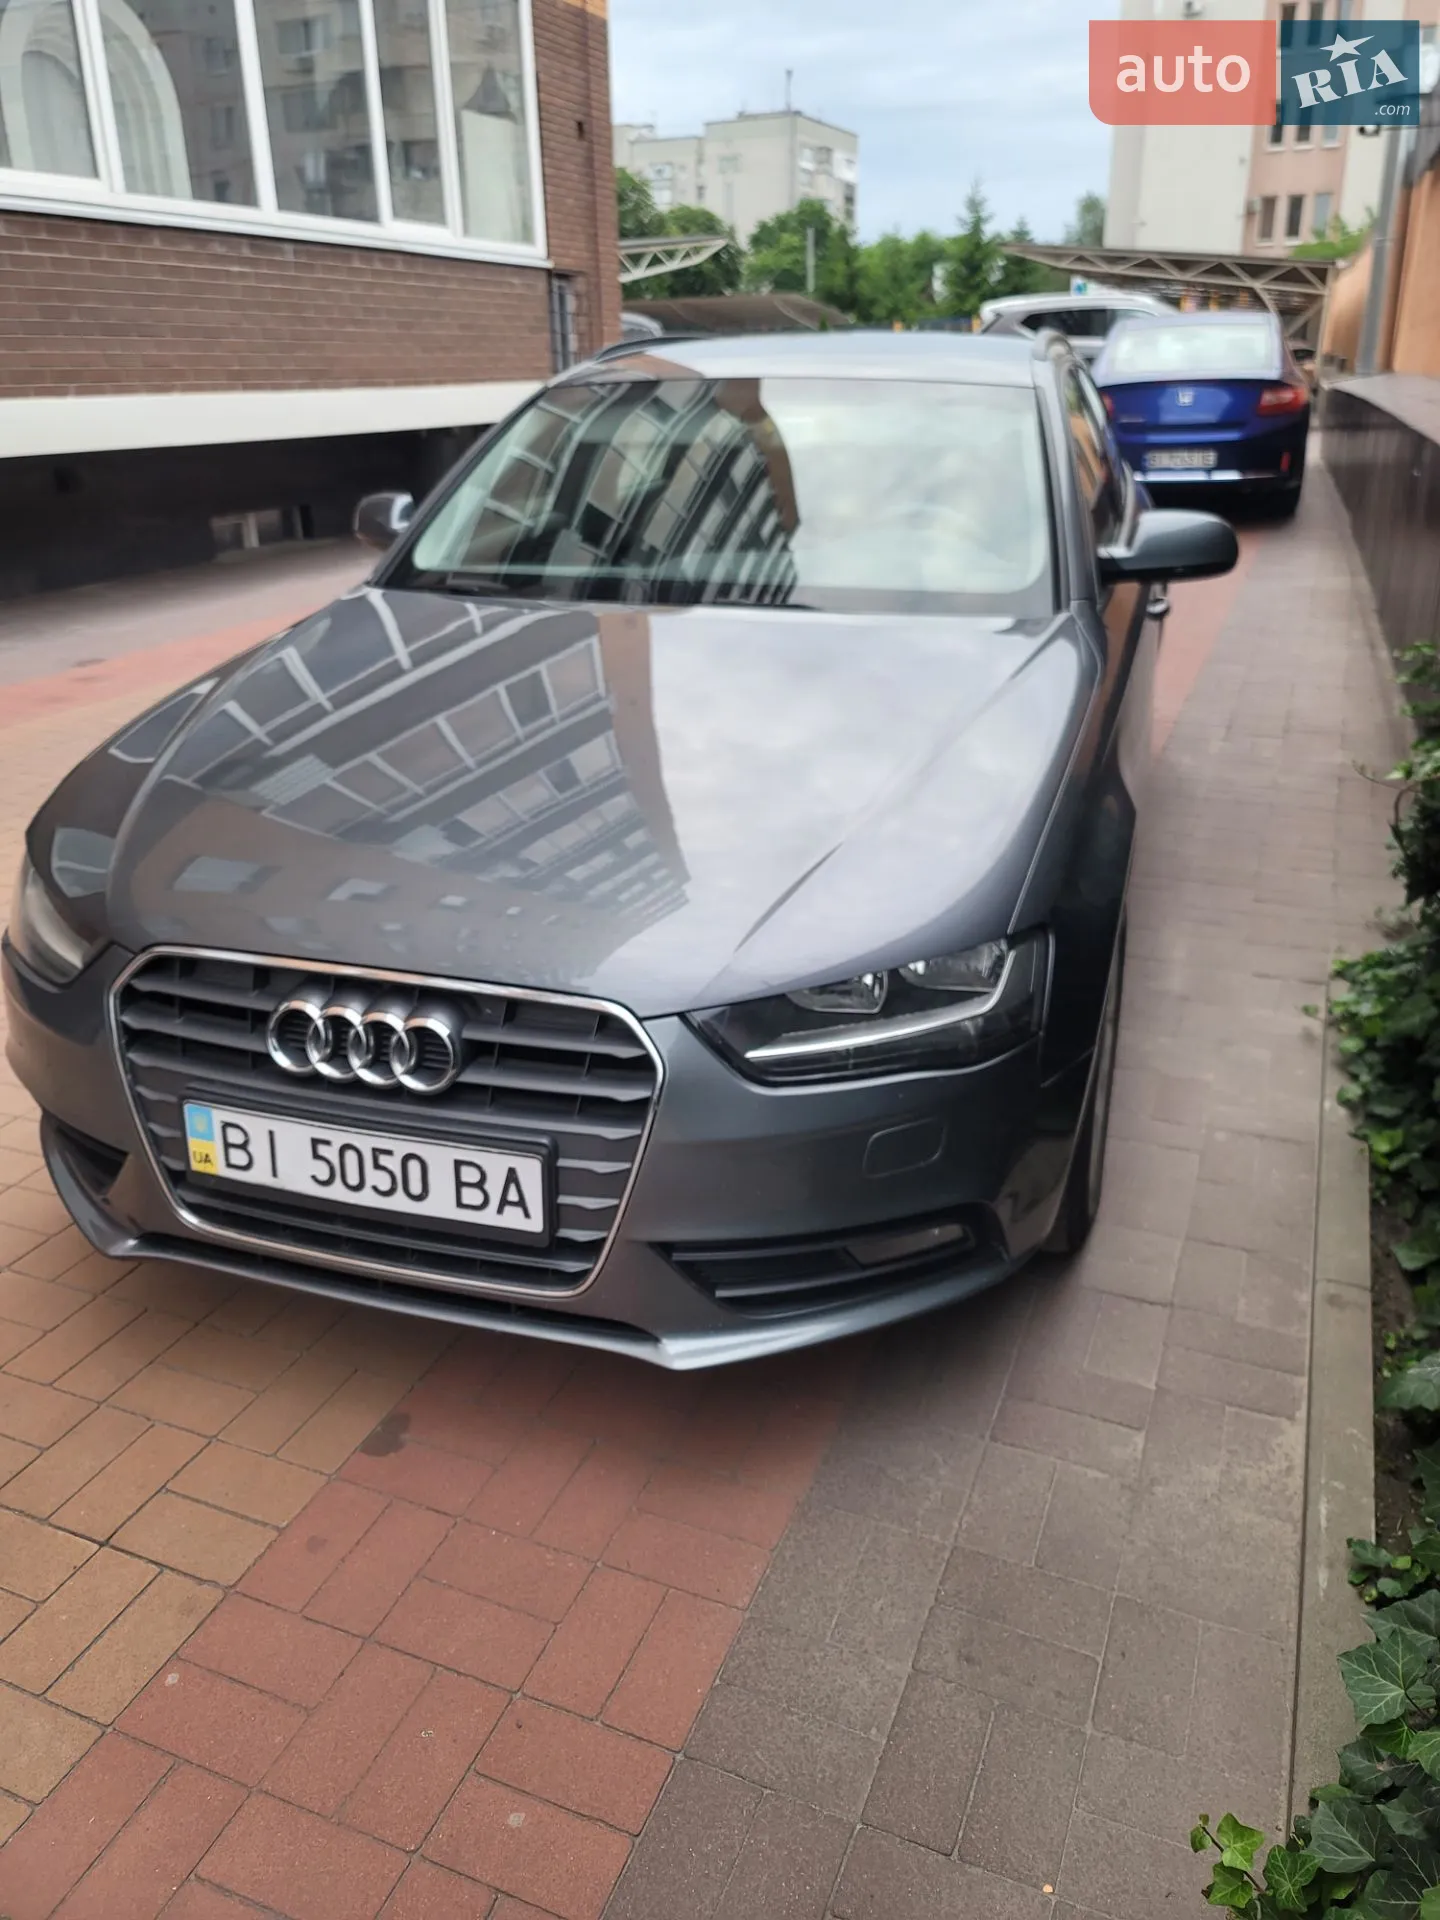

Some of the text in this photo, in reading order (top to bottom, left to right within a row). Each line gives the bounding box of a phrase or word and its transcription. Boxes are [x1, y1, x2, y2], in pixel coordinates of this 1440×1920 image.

[193, 1151, 214, 1167] UA
[220, 1120, 532, 1220] BI 5050 BA
